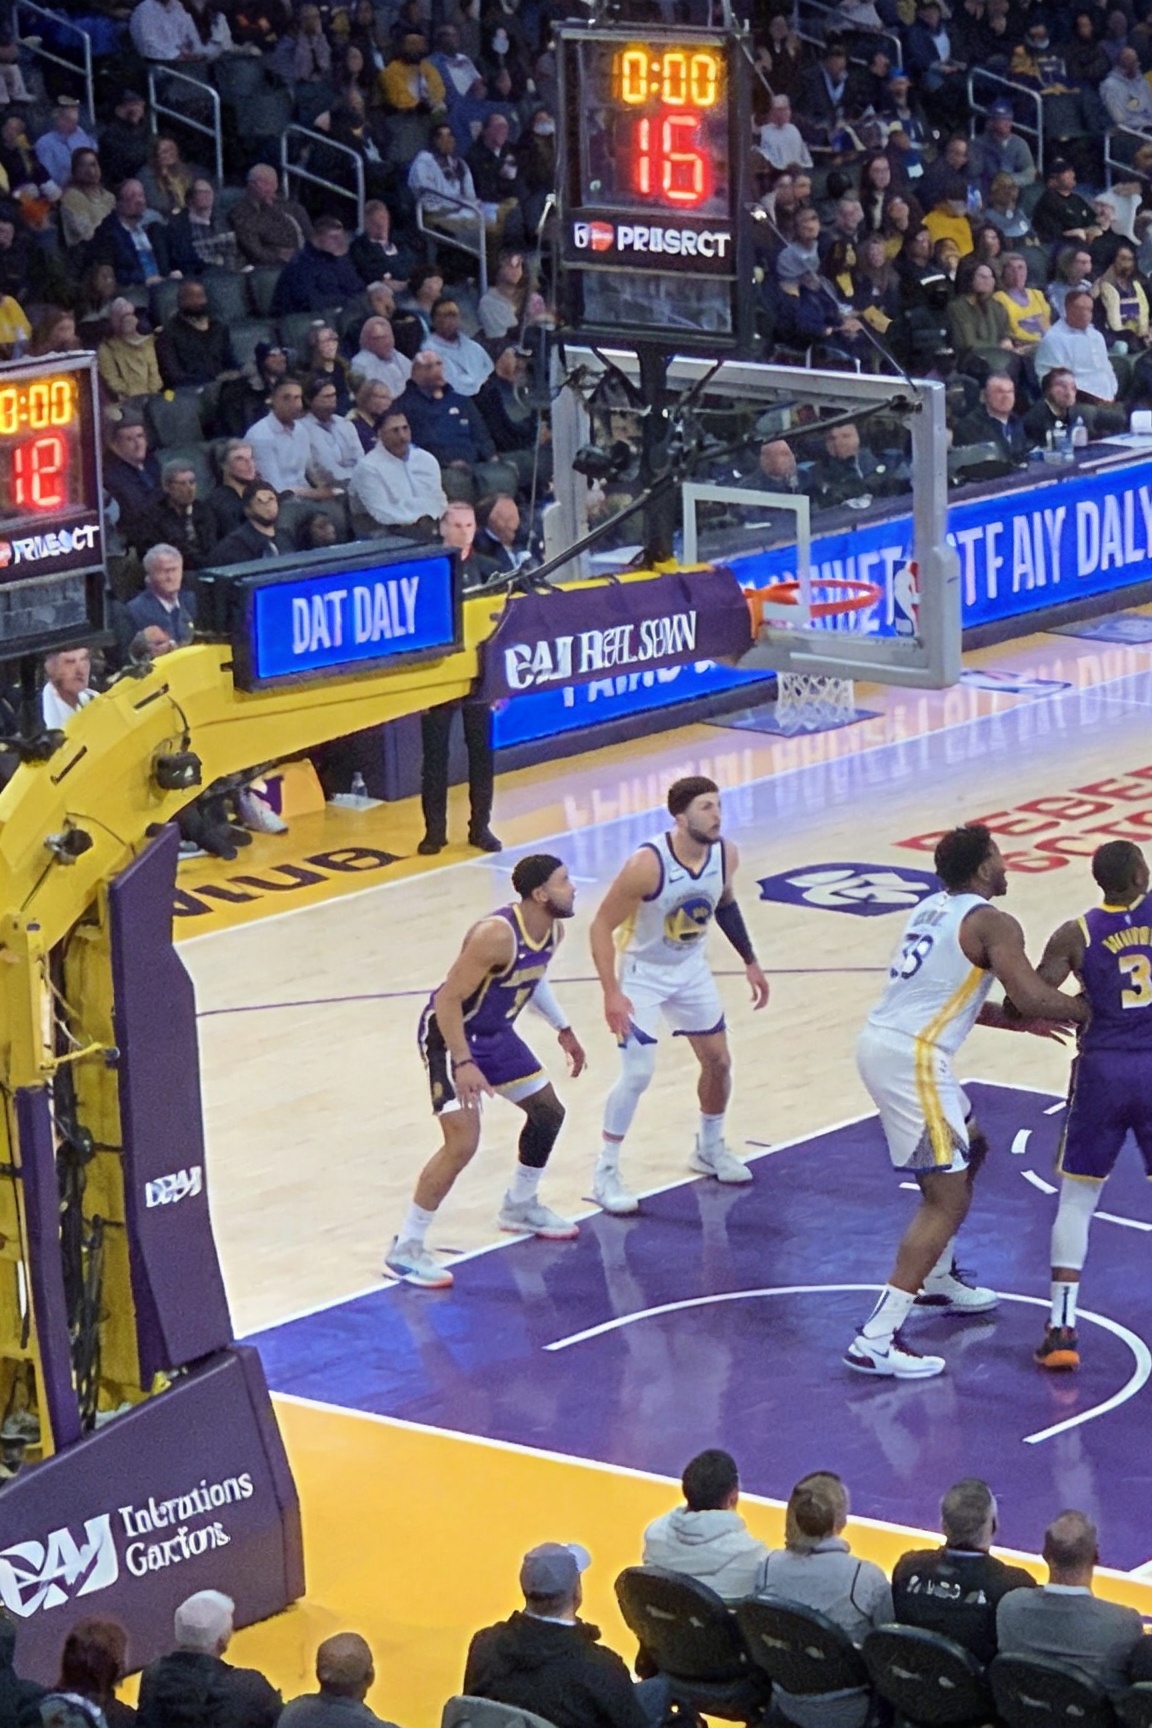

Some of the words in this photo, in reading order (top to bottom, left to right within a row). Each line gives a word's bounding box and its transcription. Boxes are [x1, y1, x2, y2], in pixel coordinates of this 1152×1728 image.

[621, 51, 717, 106] 0:00
[639, 115, 703, 200] 16
[292, 590, 348, 655] DAT
[353, 576, 420, 646] DALY
